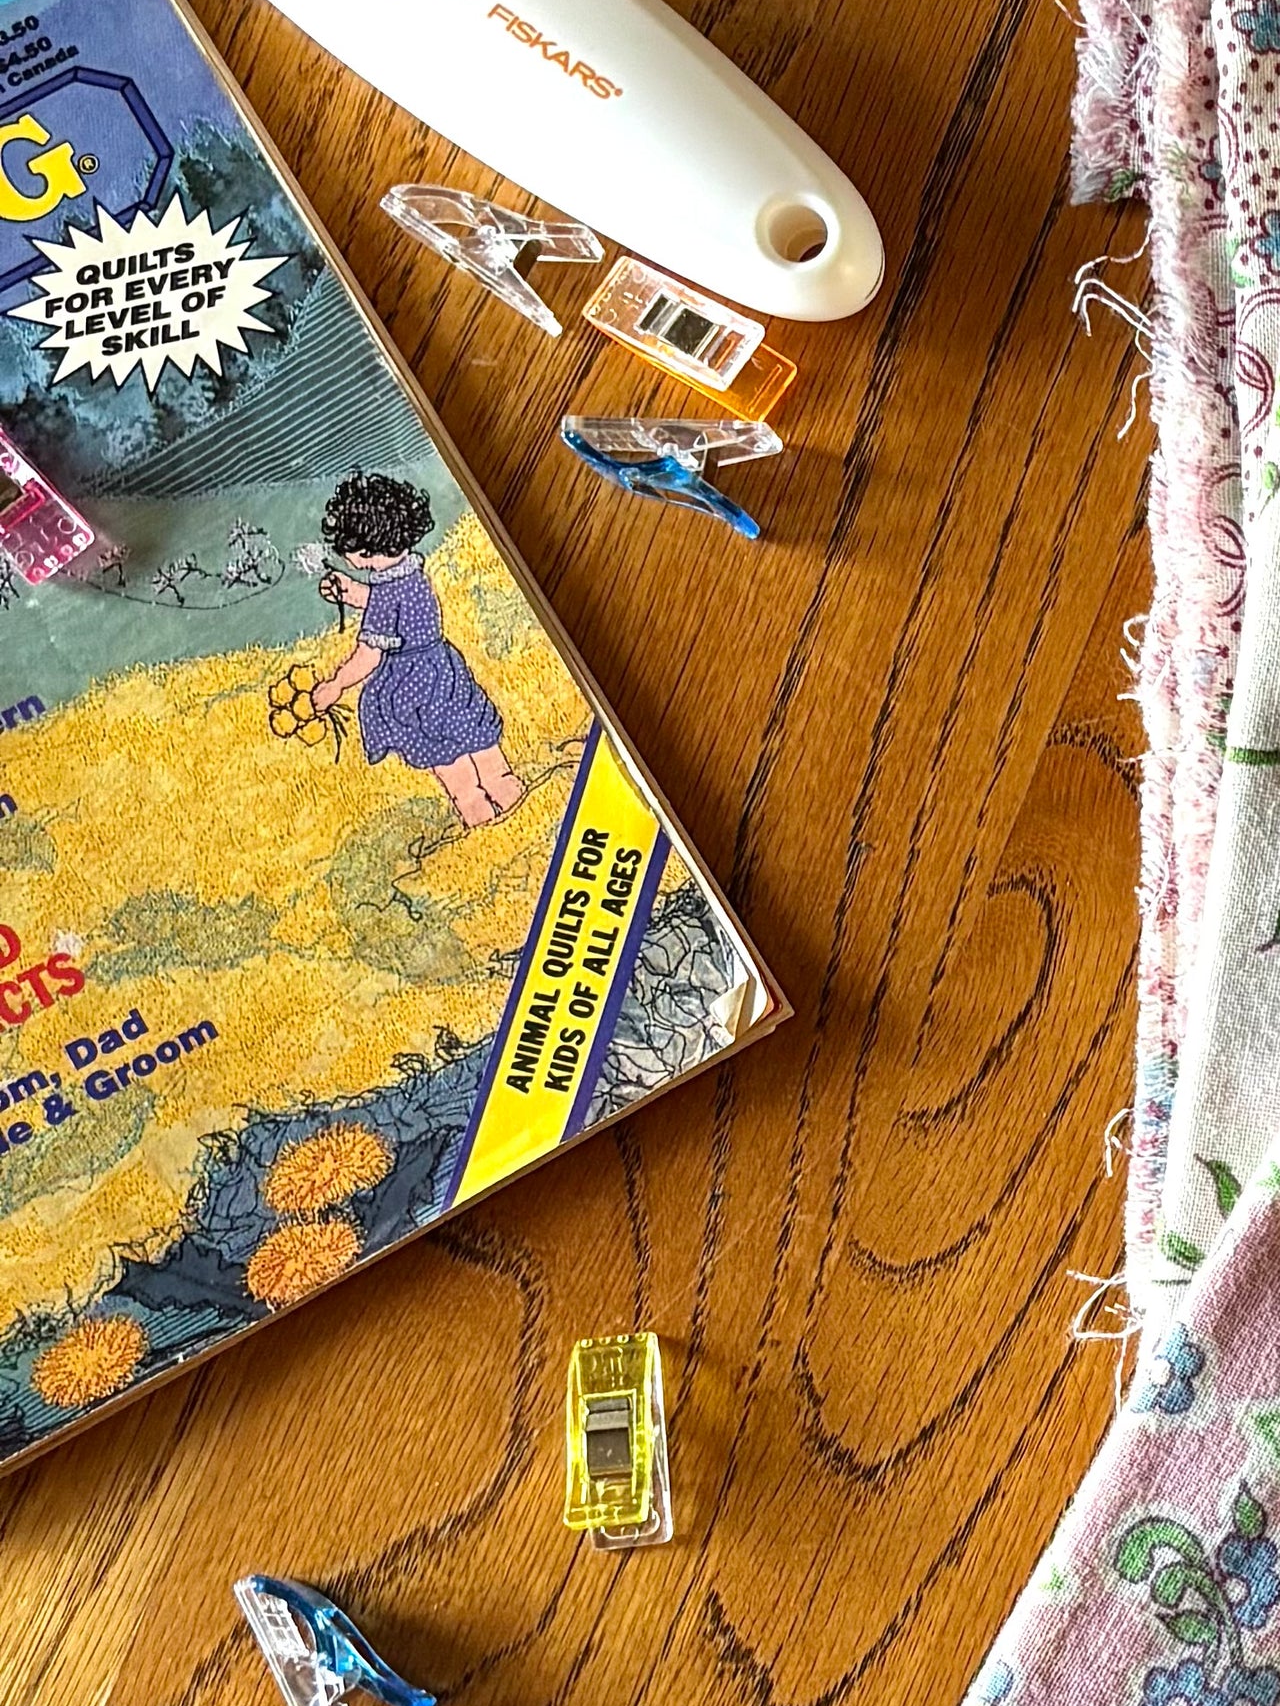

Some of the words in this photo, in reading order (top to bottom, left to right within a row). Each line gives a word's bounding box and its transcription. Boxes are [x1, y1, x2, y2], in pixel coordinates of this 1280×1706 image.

[8, 45, 79, 86] Canada
[487, 3, 614, 99] FISKARS
[45, 287, 113, 318] FOR
[125, 257, 236, 301] EVERY
[76, 243, 195, 285] QUILTS
[65, 301, 171, 340] LEVEL
[181, 286, 226, 312] OF
[101, 320, 200, 356] SKILL
[600, 847, 643, 918] AGES
[506, 988, 561, 1093] ANIMAL
[542, 888, 590, 978] QUILTS
[571, 828, 609, 881] FOR
[582, 926, 619, 976] ALL
[0, 953, 85, 1032] CTS
[568, 981, 599, 1019] OF
[65, 1008, 149, 1071] Dad
[544, 1027, 586, 1092] KIDS
[43, 1094, 78, 1125] &
[84, 1020, 219, 1101] Groom
